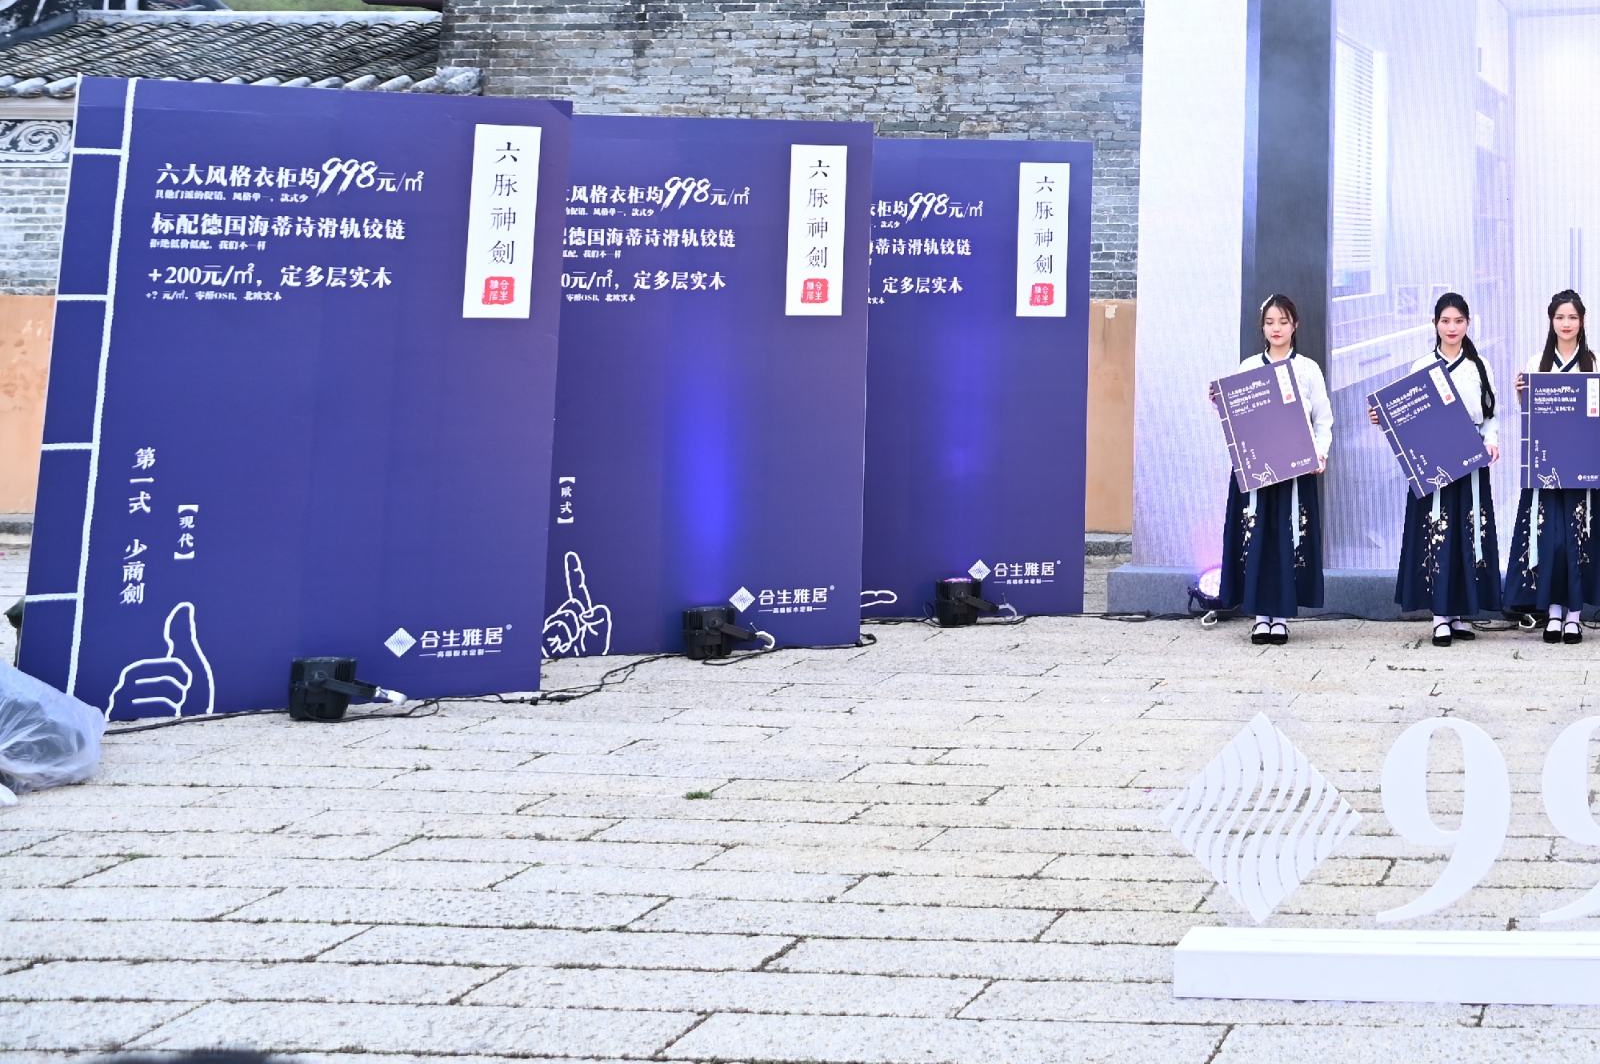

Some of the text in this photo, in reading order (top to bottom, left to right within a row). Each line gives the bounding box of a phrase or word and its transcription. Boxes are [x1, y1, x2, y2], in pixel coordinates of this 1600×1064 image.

[566, 176, 750, 211] 风格衣柜均998元/㎡
[151, 212, 406, 240] 标配德国海蒂诗滑轨铰链
[563, 227, 736, 248] 德国海蒂诗滑轨铰链
[869, 238, 972, 256] 蒂诗滑轨铰链
[758, 587, 827, 605] 合生雅居
[420, 627, 503, 649] 合生雅居
